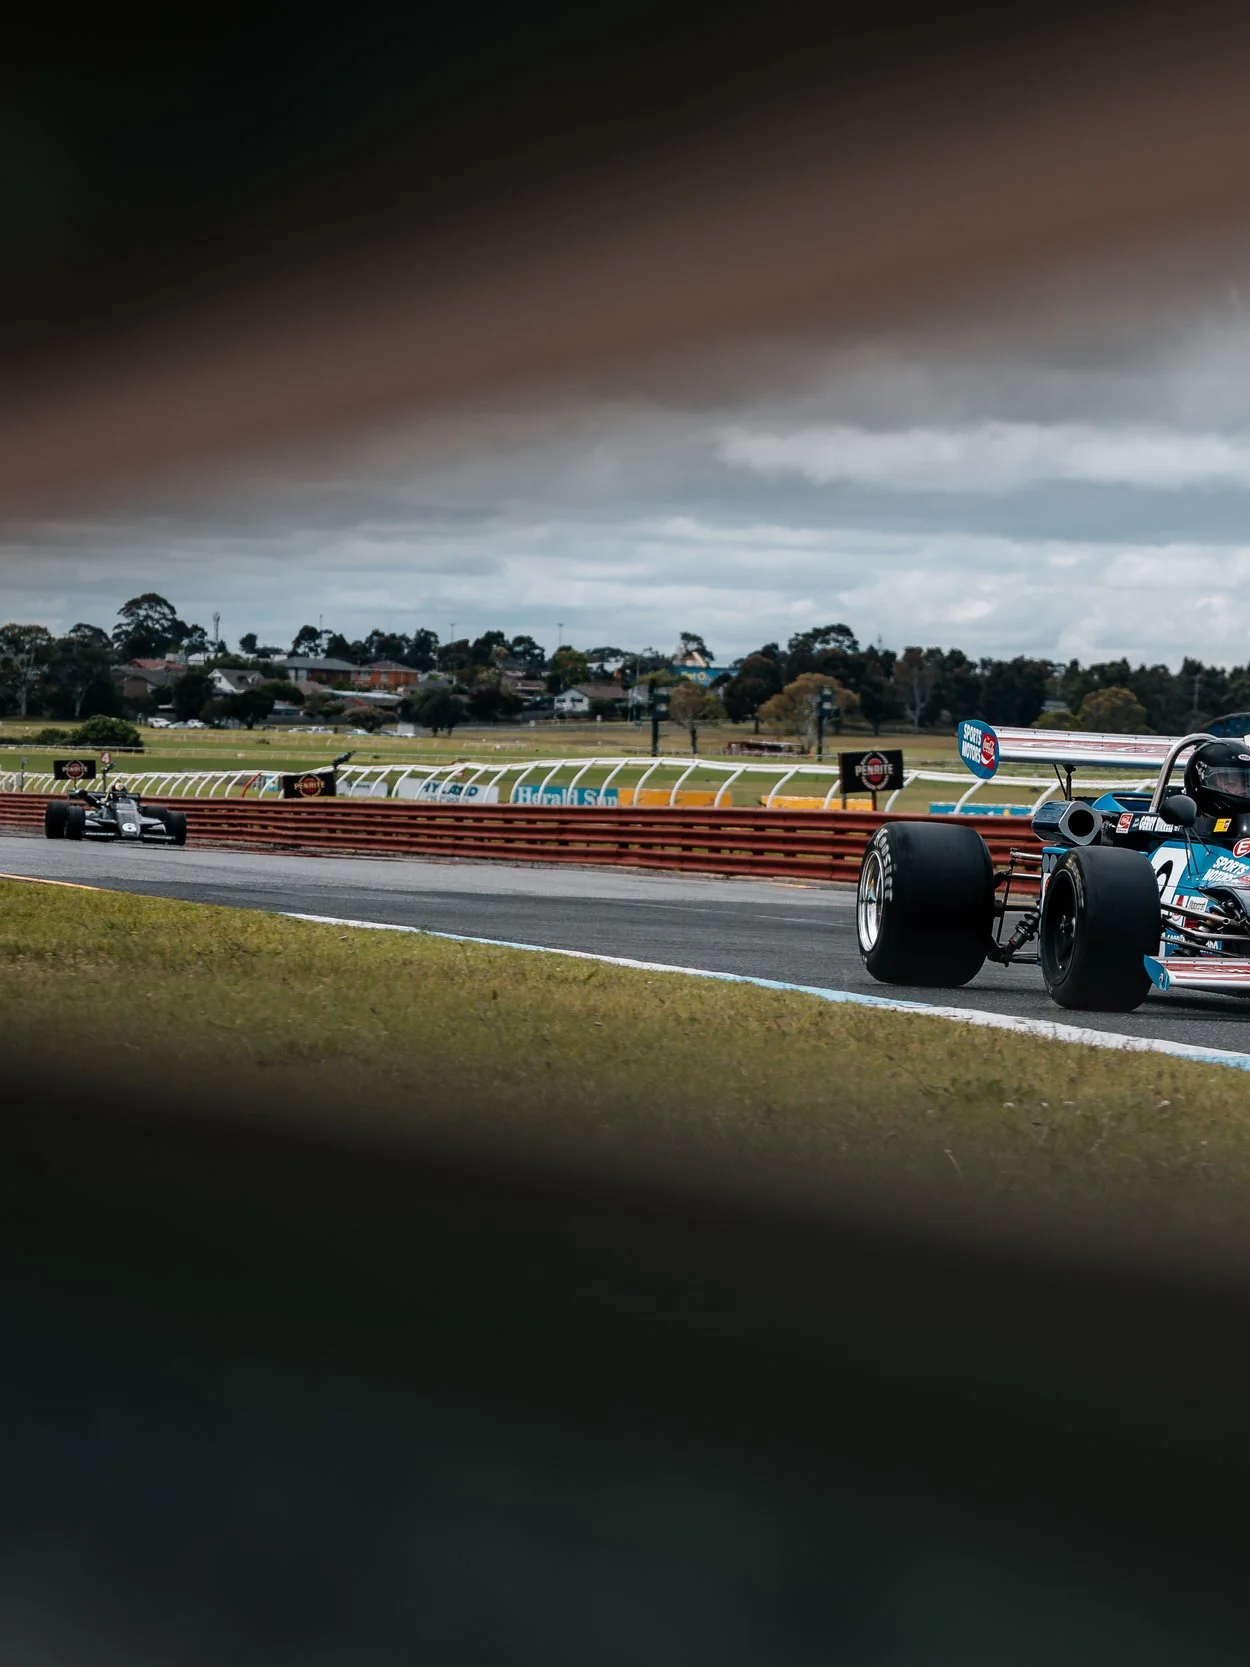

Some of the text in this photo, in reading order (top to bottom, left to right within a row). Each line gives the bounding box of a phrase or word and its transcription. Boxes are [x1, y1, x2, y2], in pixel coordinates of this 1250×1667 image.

[963, 723, 982, 746] SPORTS
[102, 753, 109, 763] 4
[962, 740, 981, 764] MOTORS
[855, 763, 893, 777] PENRITE
[294, 780, 326, 790] PENRITE
[122, 822, 137, 832] 6
[1212, 855, 1250, 875] SPORTS
